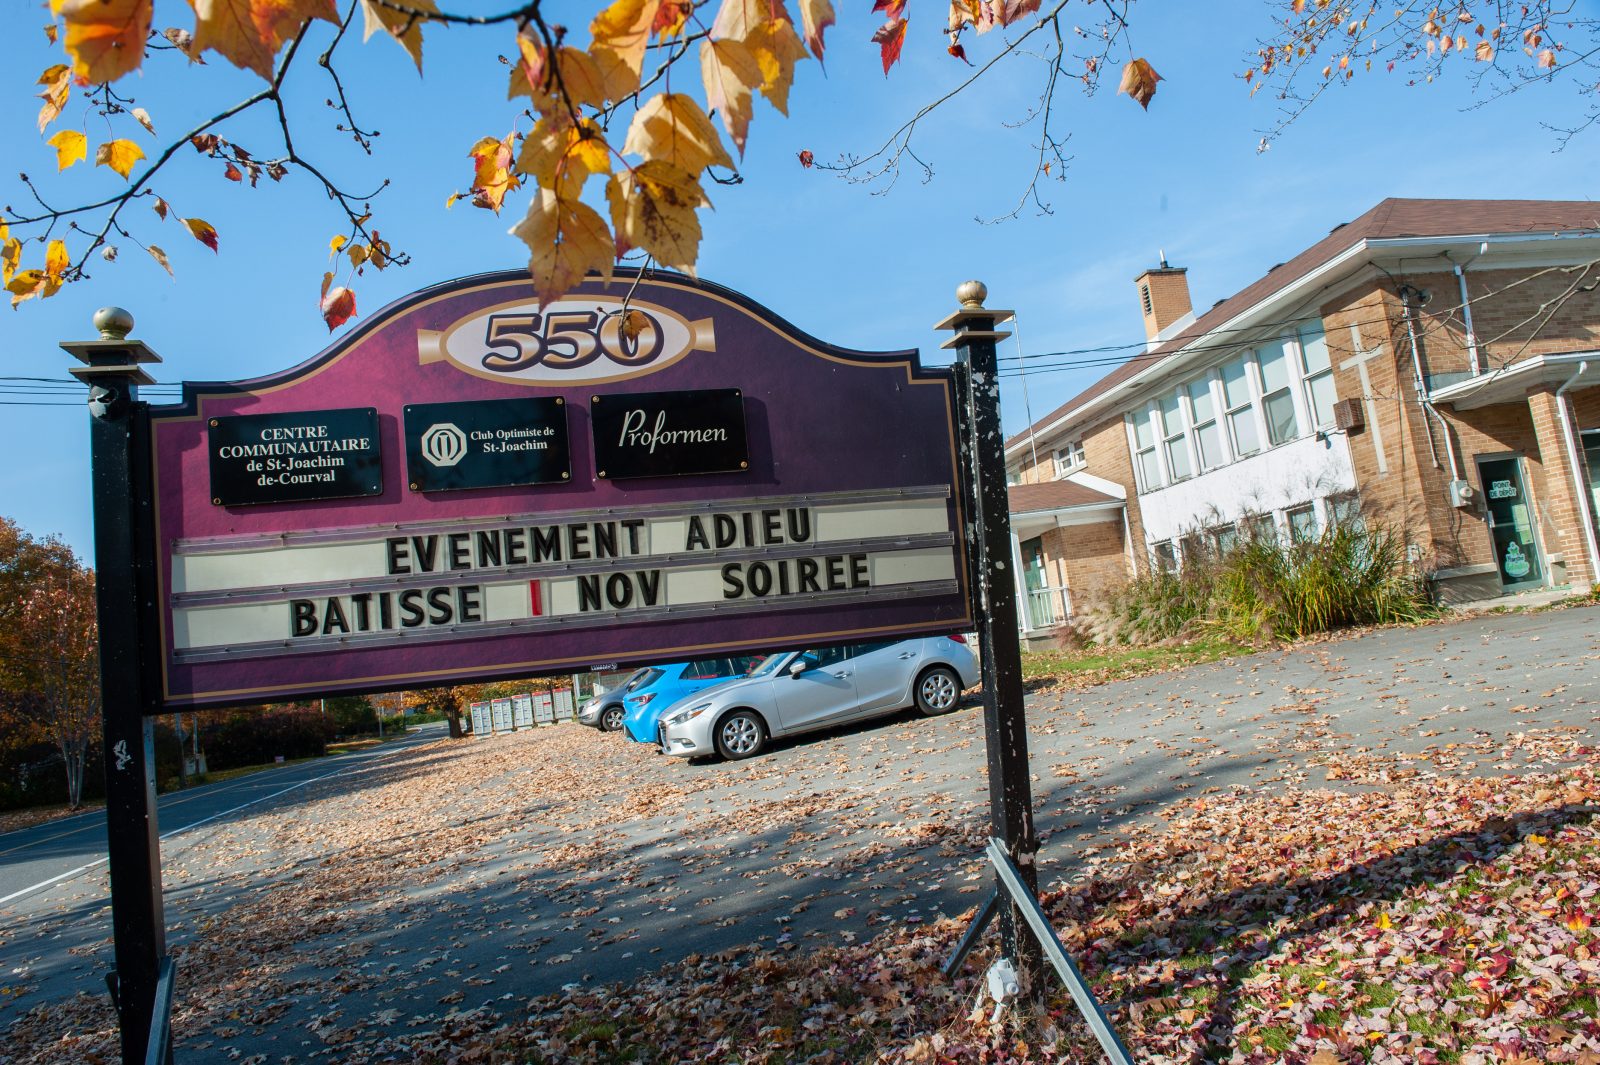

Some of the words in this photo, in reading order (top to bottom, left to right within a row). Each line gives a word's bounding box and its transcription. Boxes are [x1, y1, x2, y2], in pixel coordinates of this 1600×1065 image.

[482, 309, 665, 372] 550
[260, 425, 328, 441] CENTRE
[470, 431, 494, 441] Club
[496, 428, 542, 440] Optimiste
[543, 427, 555, 436] de
[618, 409, 728, 454] Proformen
[219, 438, 370, 458] COMMUNAUTAIRE
[483, 440, 548, 453] St-Joachim
[246, 460, 264, 472] de
[266, 455, 345, 471] St-Joachim
[257, 470, 335, 486] de-Courval
[386, 519, 645, 575] EVENEMENT
[685, 508, 810, 551] ADIEU
[290, 585, 481, 637] BATISSE
[577, 570, 660, 611] NOV
[722, 554, 871, 599] SOIREE
